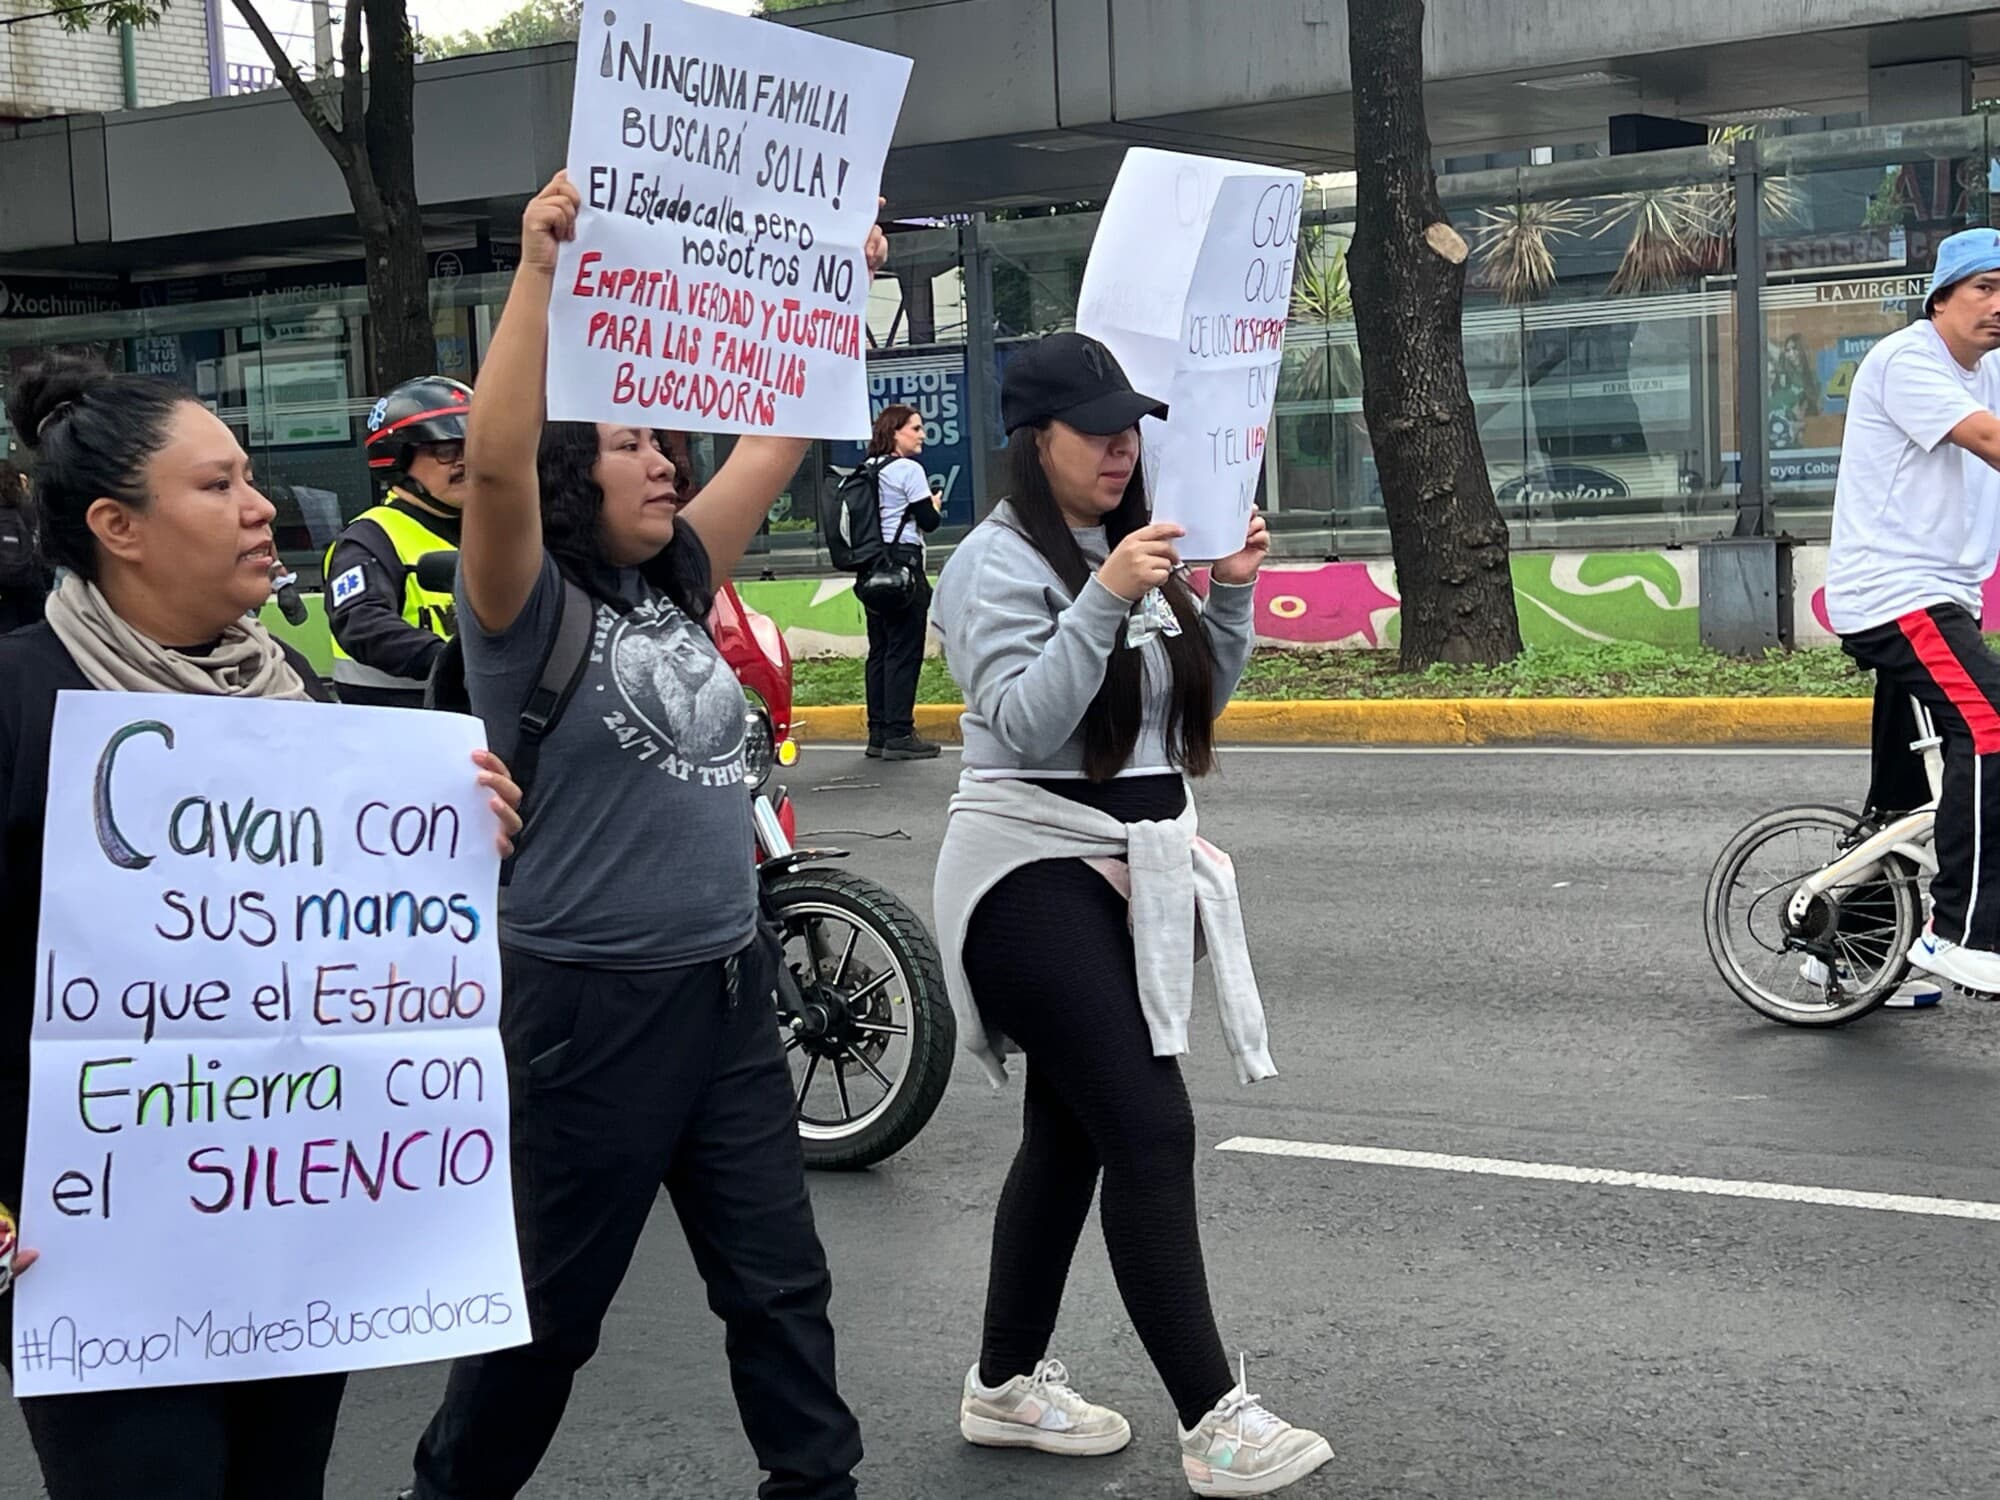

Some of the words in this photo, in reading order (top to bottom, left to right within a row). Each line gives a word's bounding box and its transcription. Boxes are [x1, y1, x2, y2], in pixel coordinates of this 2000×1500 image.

[752, 74, 849, 135] FAMILIA
[622, 107, 748, 175] BUSCARÁ
[756, 139, 850, 210] SOLA!
[589, 166, 618, 212] El
[624, 173, 692, 225] Estado
[754, 213, 814, 250] pero
[682, 235, 800, 286] nosotros
[1245, 257, 1293, 304] QUE
[1820, 285, 1844, 301] LA
[1849, 280, 1921, 300] VIRGEN
[587, 311, 653, 359] PARA
[662, 321, 702, 366] LAS
[711, 331, 807, 399] FAMILIAS
[688, 282, 755, 328] VERDAD
[760, 299, 777, 341] Y
[776, 298, 861, 360] JUSTICIA
[612, 362, 776, 427] BUSCADORAS
[869, 368, 958, 397] UTBOL
[1770, 463, 1801, 478] ayor
[1804, 461, 1838, 476] Cobe
[602, 710, 661, 761] 24/7
[657, 752, 695, 782] AT
[698, 760, 744, 787] THIS
[93, 719, 324, 870] Cavan
[356, 801, 460, 859] con
[155, 890, 277, 947] sus
[296, 888, 481, 944] manos
[45, 949, 99, 1023] lo
[121, 977, 231, 1044] que
[252, 961, 292, 1021] el
[313, 954, 486, 1026] Estado
[79, 1052, 342, 1134] Entierra
[386, 1056, 484, 1107] con
[51, 1151, 113, 1219] el
[187, 1127, 494, 1214] SILENCIO
[17, 1288, 513, 1382] #ApoyoMadresBuscadoras
